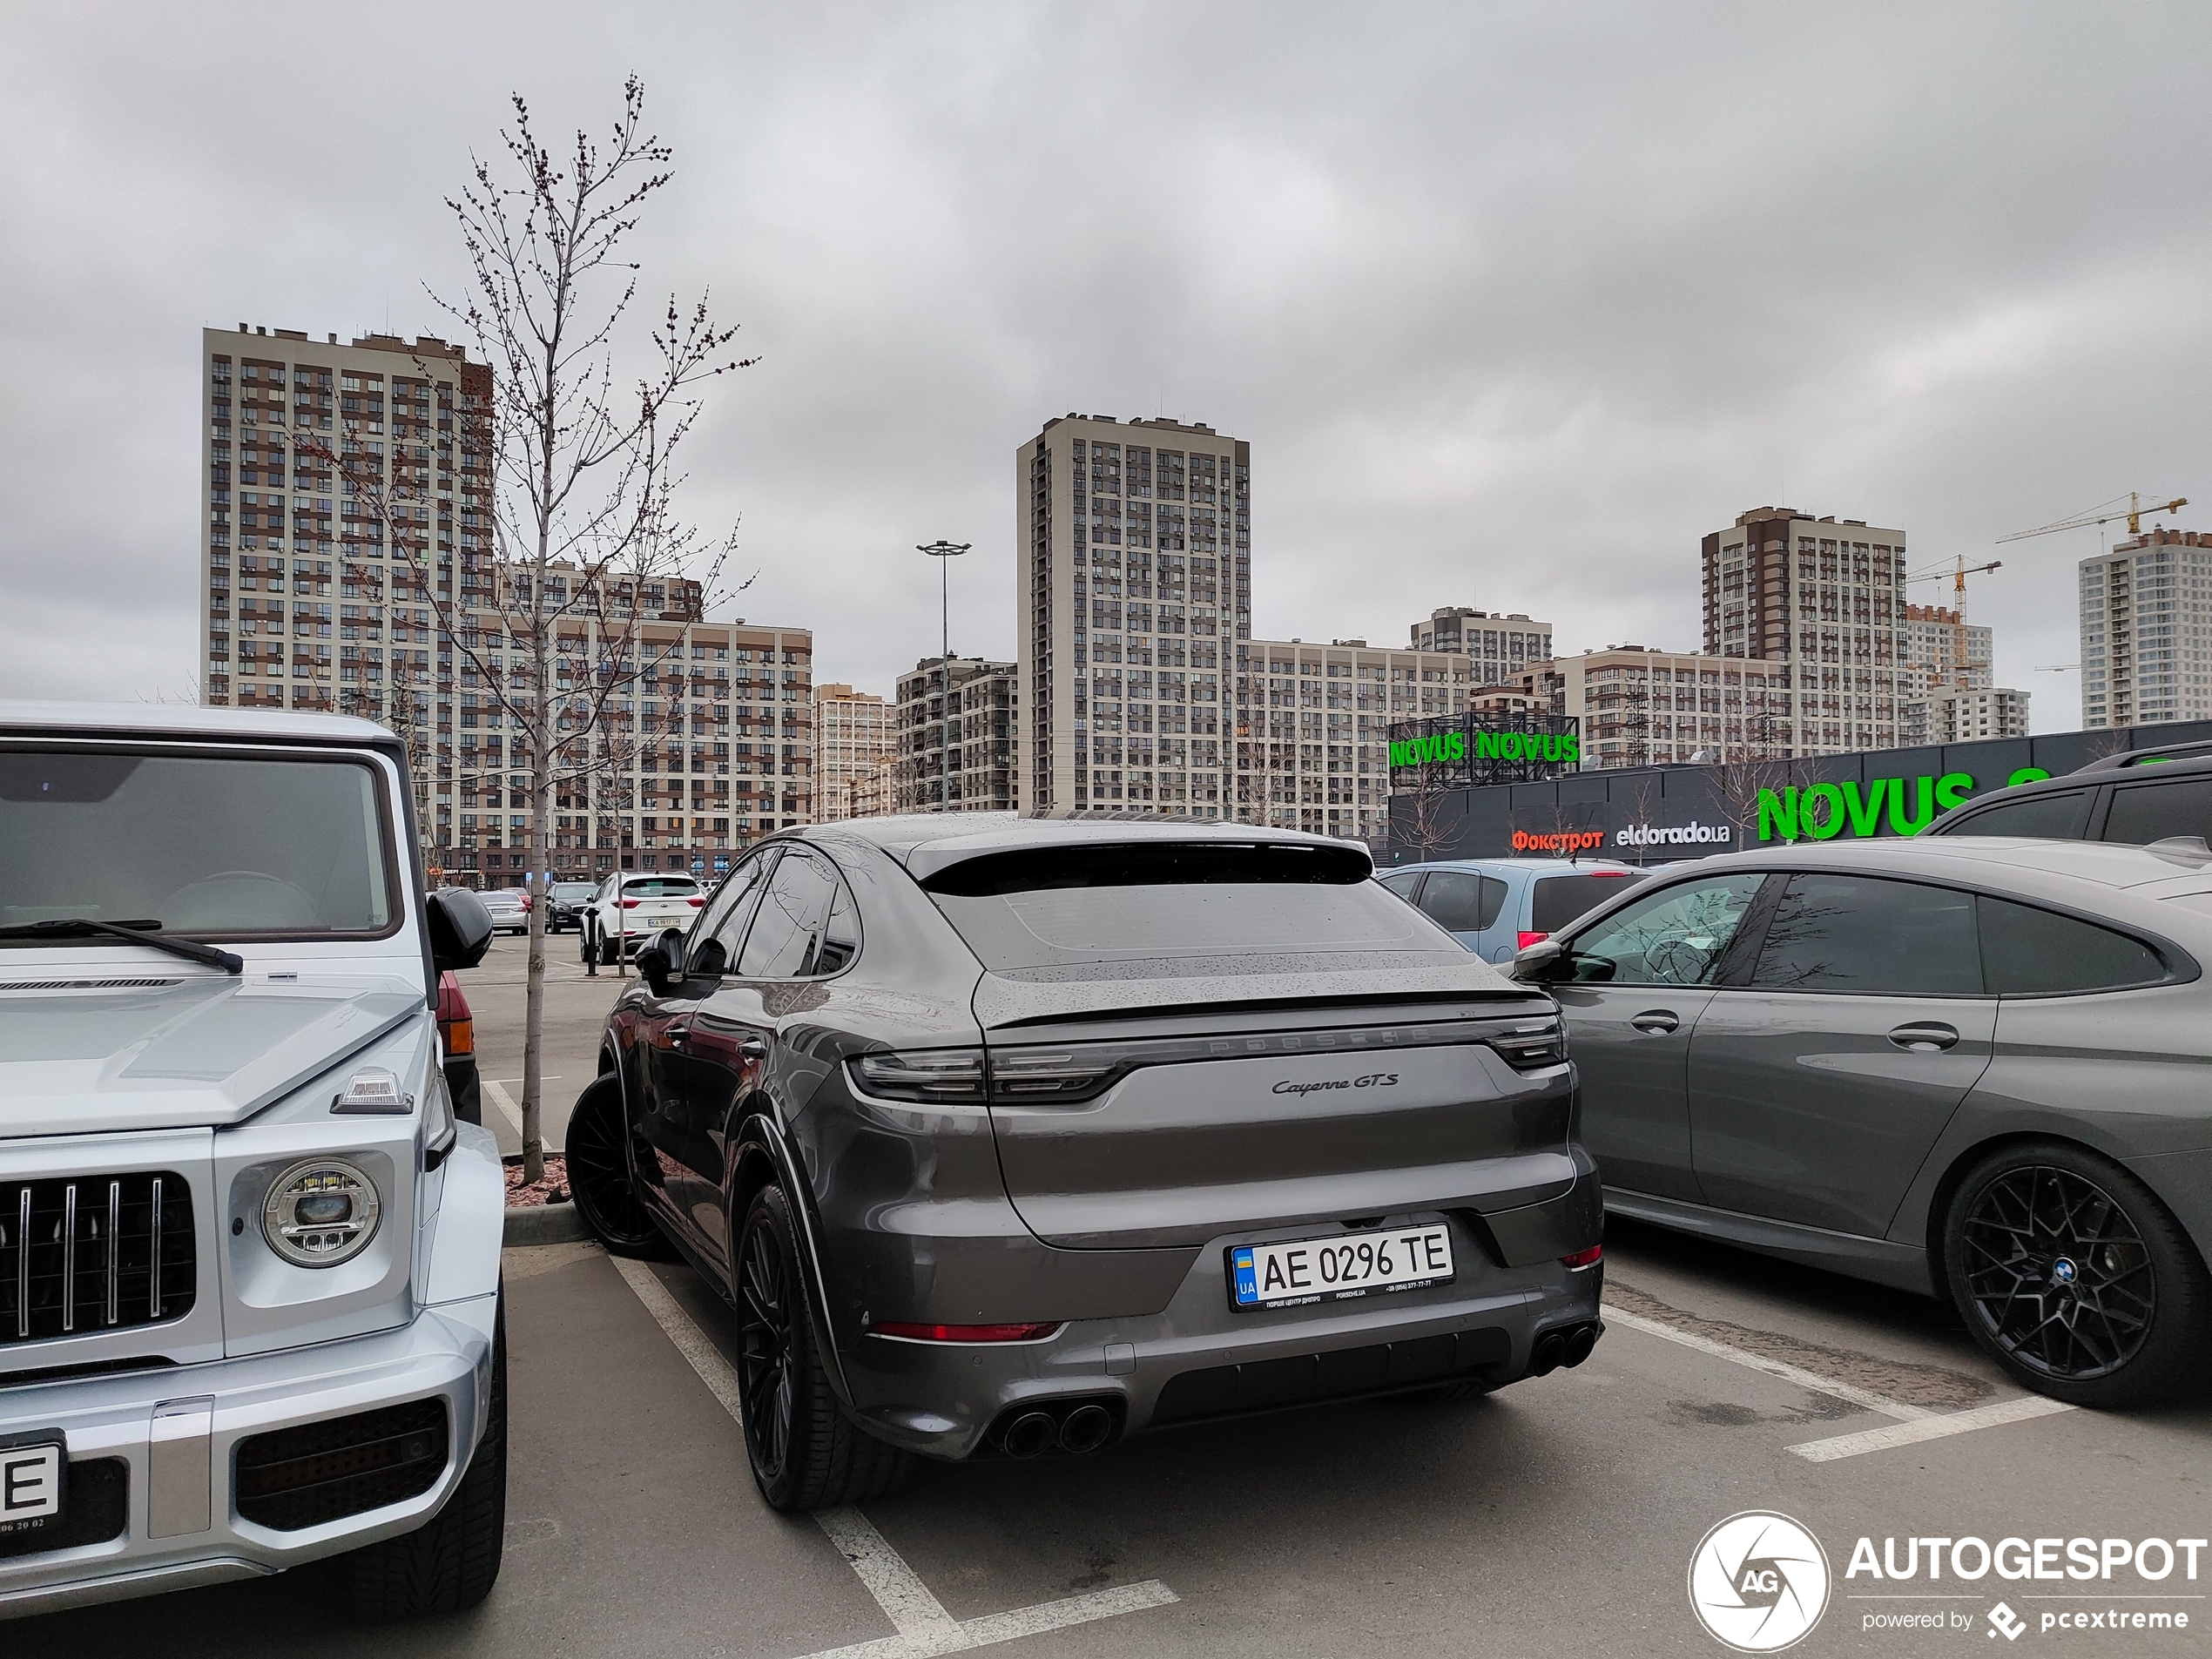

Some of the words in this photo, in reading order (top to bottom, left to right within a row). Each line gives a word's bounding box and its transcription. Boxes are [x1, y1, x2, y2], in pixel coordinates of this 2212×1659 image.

[1390, 732, 1465, 767] NOVUS
[1477, 732, 1579, 762] NOVUS
[1512, 830, 1604, 852] Фокстрот
[1210, 1028, 1430, 1054] PORSCHE
[1271, 1080, 1351, 1097] Cayenne
[1353, 1074, 1399, 1089] GTS
[1264, 1250, 1312, 1292] AE
[1319, 1239, 1393, 1284] 0296
[1400, 1233, 1447, 1272] TE
[1239, 1282, 1256, 1295] UA
